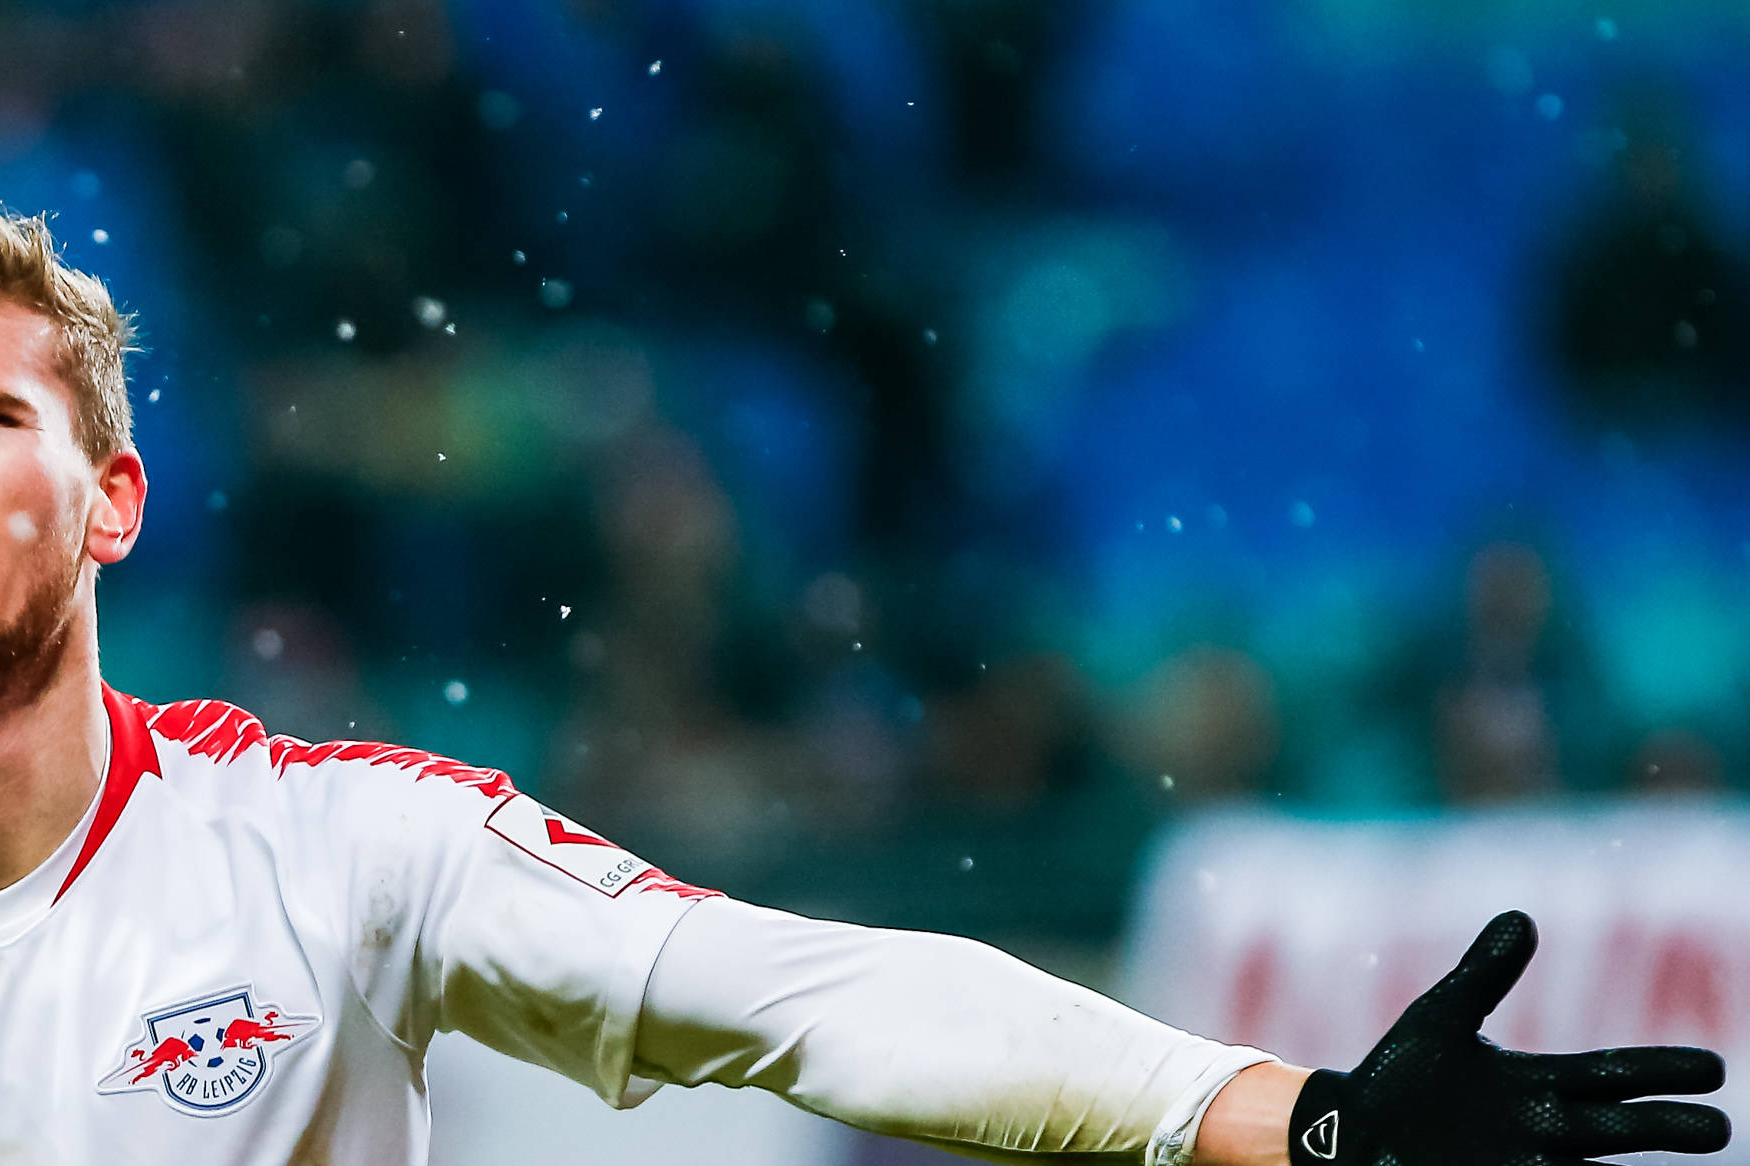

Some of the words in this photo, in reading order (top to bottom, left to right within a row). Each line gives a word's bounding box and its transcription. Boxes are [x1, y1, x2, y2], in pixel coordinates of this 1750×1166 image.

[600, 871, 622, 888] CG
[176, 1073, 198, 1095] RB
[203, 1057, 257, 1099] LEIPZIG
